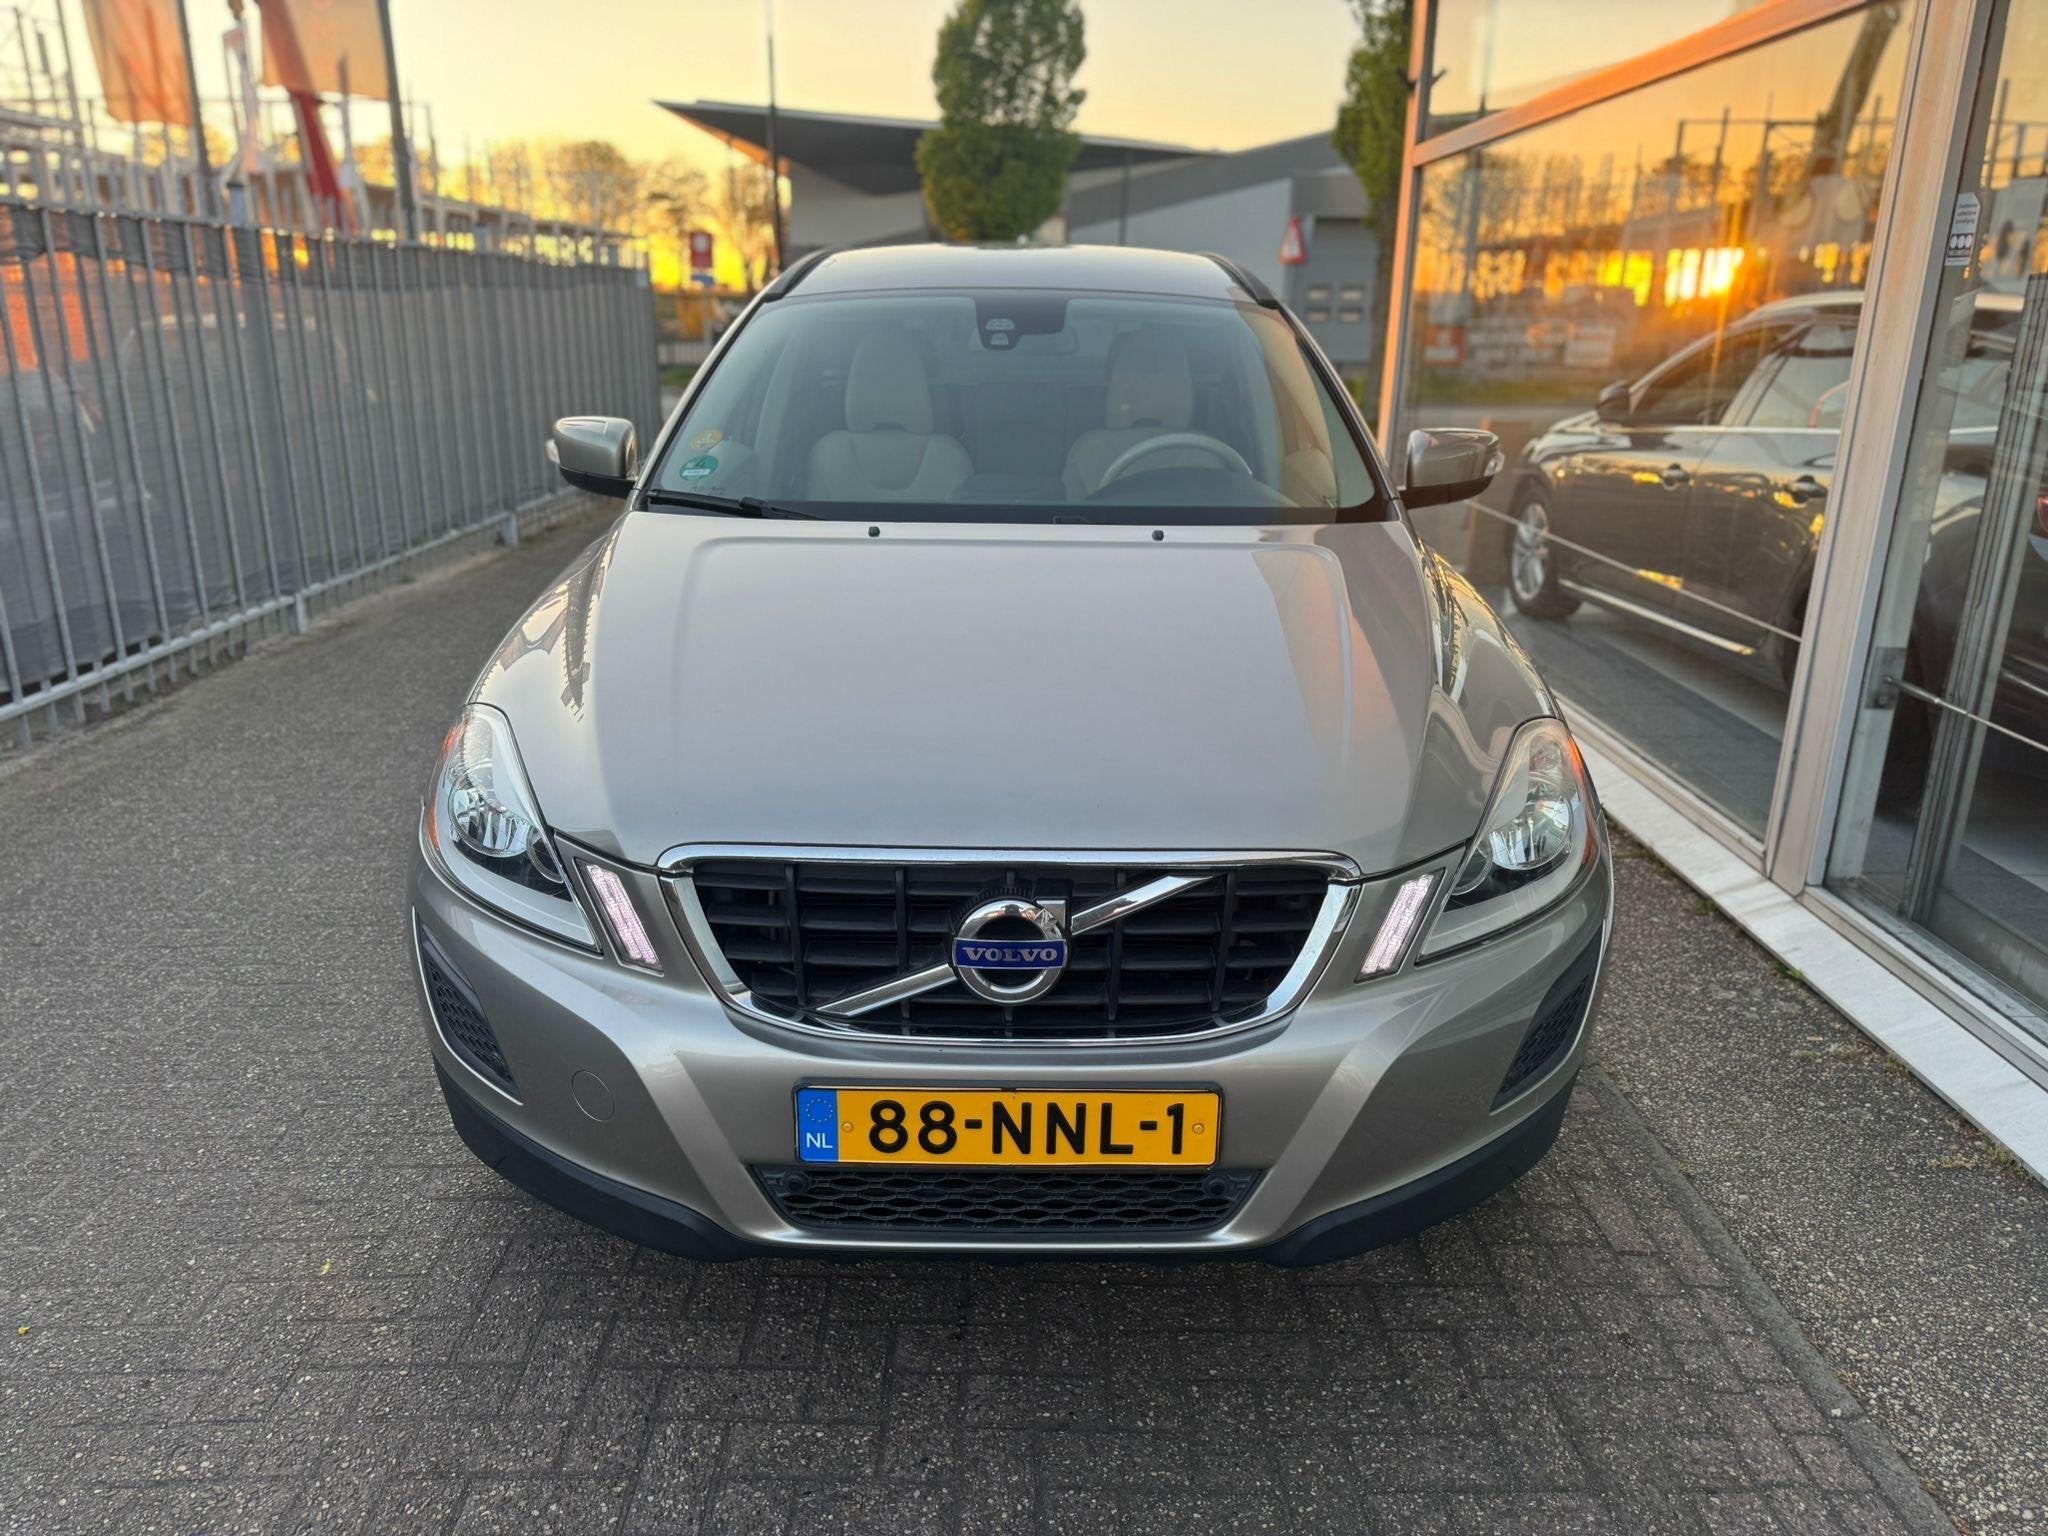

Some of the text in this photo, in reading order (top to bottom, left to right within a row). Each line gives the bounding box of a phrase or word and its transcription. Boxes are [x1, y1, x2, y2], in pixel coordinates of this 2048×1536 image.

[962, 947, 1058, 962] VOLVO
[869, 1100, 1185, 1155] 88-NNL-1
[806, 1132, 833, 1148] NL
